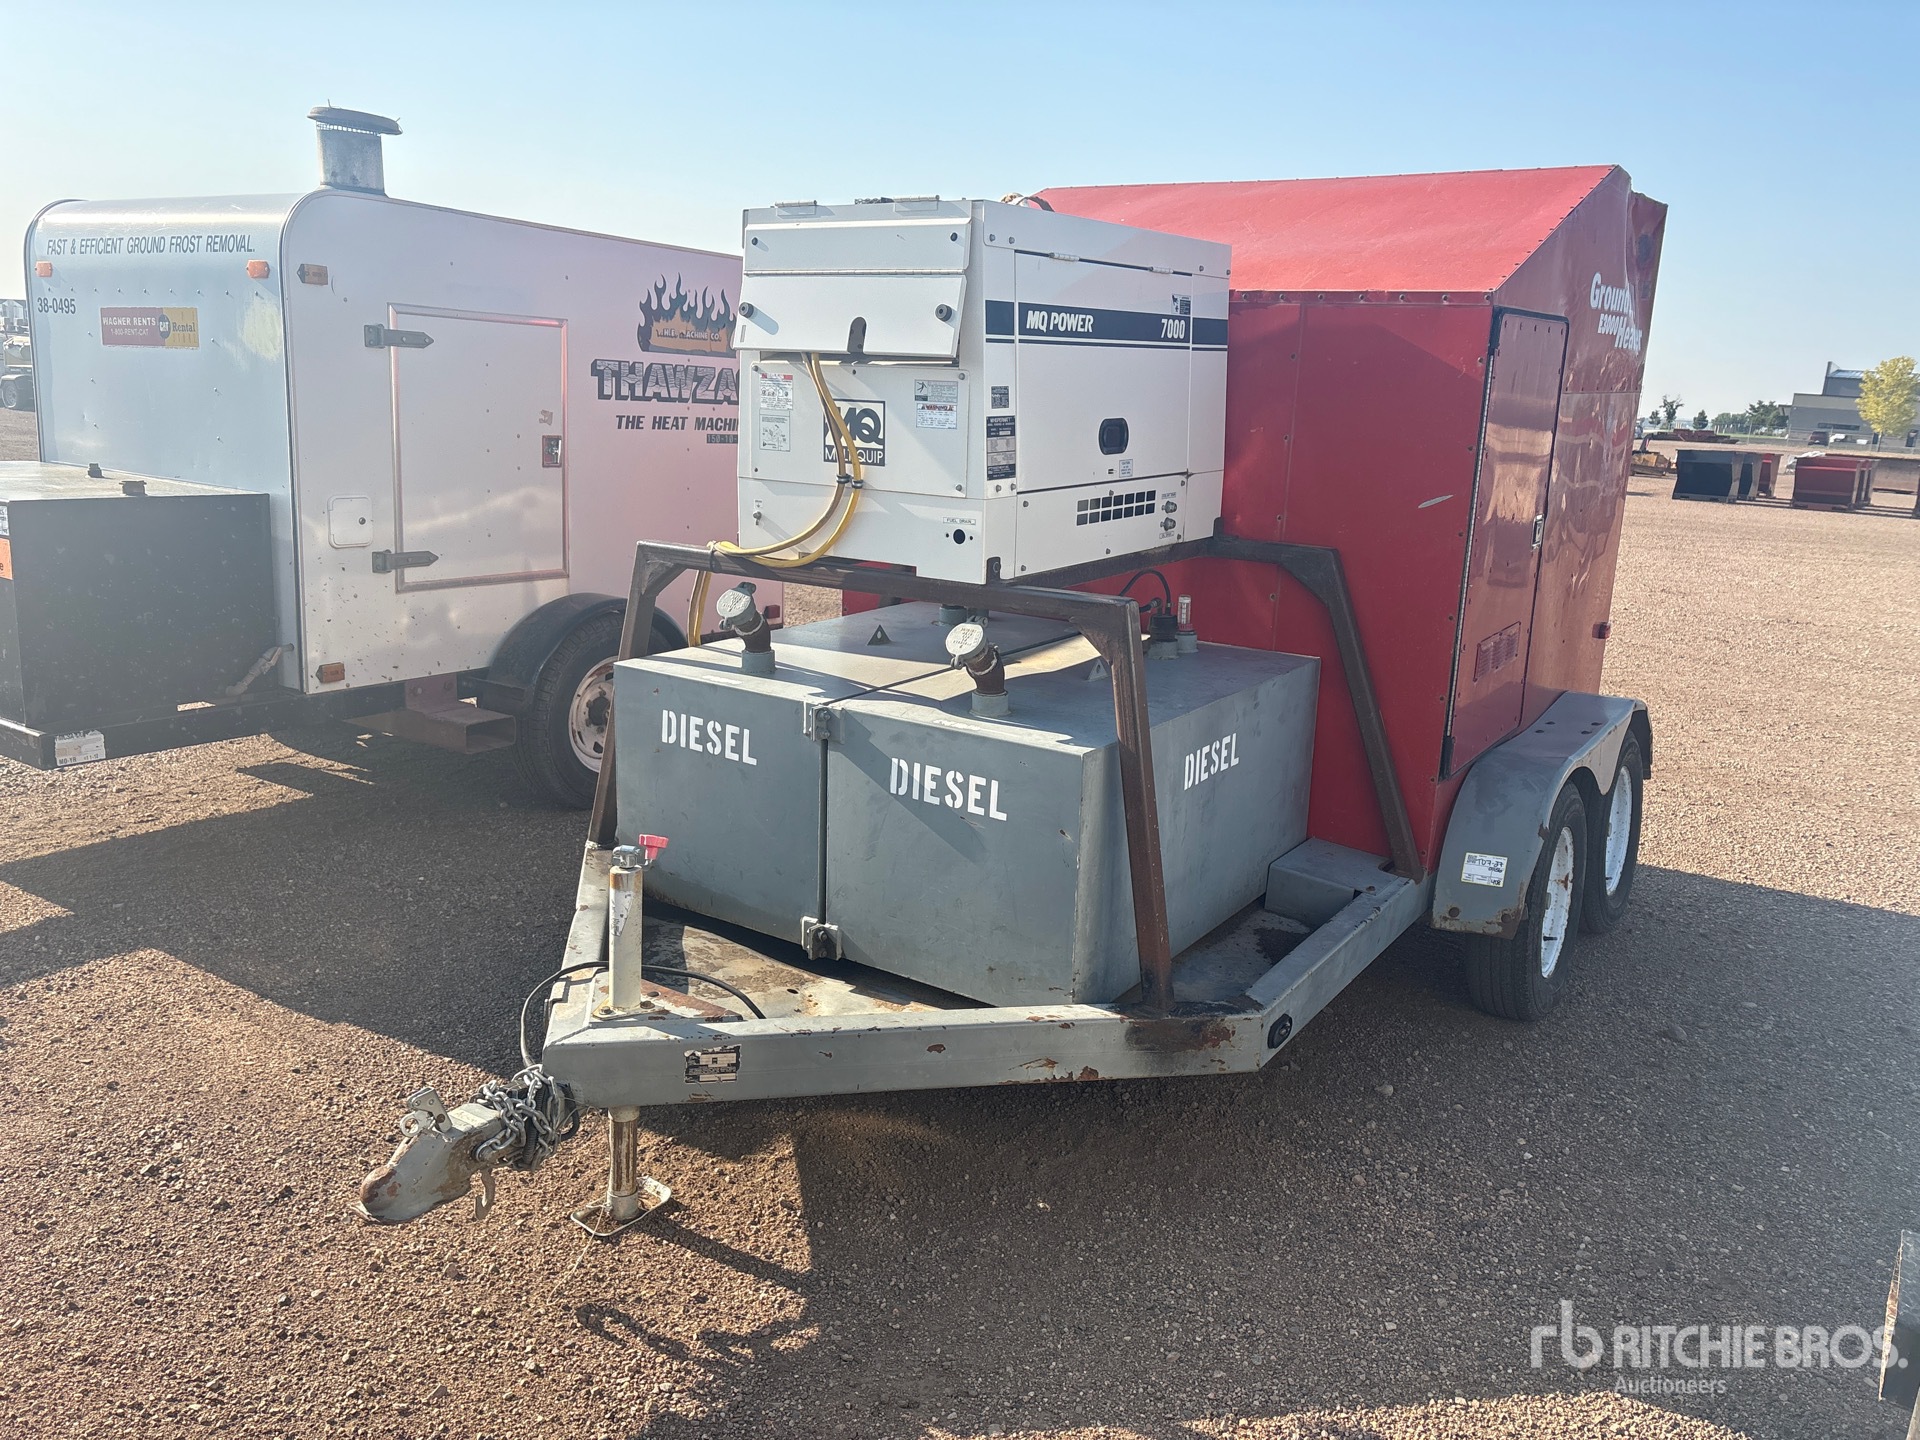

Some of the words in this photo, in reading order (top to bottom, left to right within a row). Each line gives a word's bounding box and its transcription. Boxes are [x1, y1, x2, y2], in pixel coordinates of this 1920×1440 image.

[47, 239, 68, 255] FAST
[70, 238, 77, 255] &
[80, 237, 124, 254] EFFICIENT
[127, 236, 166, 254] GROUND
[169, 235, 202, 253] FROST
[206, 234, 255, 253] REMOVAL.
[37, 297, 76, 315] 38-0495
[102, 317, 132, 326] WAGNER
[133, 317, 156, 326] RENTS
[160, 321, 169, 332] CAT
[172, 321, 196, 332] Rental
[1026, 310, 1047, 333] MQ
[1049, 312, 1094, 333] POWER
[1161, 318, 1186, 339] 7000
[679, 331, 708, 341] ACHINE
[591, 359, 739, 405] THAWZA
[616, 415, 645, 430] THE
[652, 416, 688, 430] HEAT
[694, 417, 739, 431] MACHI
[825, 447, 884, 464] MLTQUIP
[662, 709, 757, 766] DIESEL
[1184, 732, 1239, 791] DIESEL
[890, 757, 1007, 821] DIESEL
